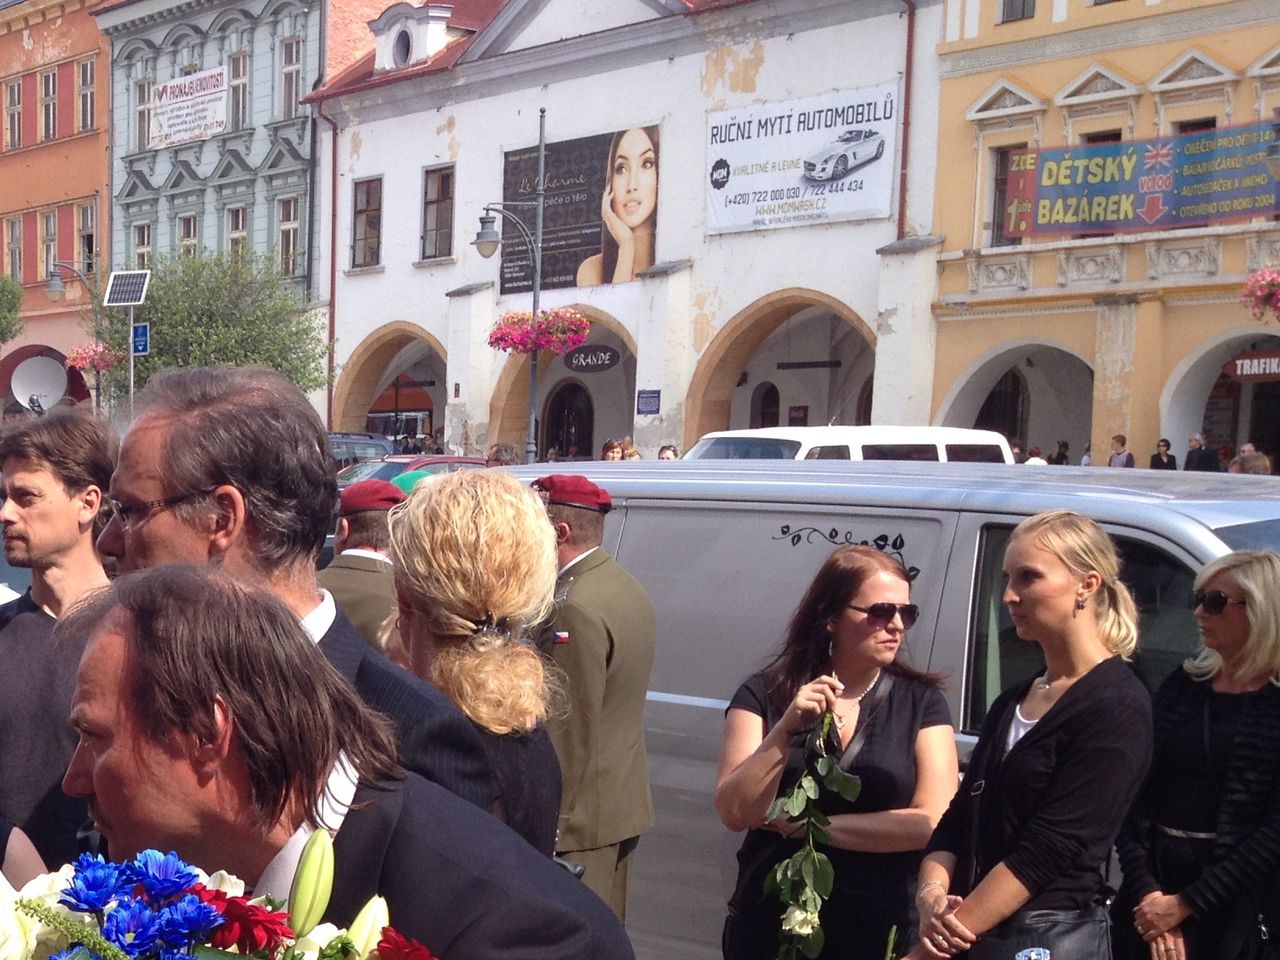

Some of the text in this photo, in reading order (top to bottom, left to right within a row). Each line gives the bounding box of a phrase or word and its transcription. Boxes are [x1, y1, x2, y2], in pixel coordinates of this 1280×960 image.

[710, 114, 753, 145] RUČNÍ
[797, 92, 894, 133] AUTOMOBILŮ
[1041, 146, 1138, 187] DĚTSKÝ
[752, 190, 769, 203] 722
[786, 186, 801, 199] 030
[810, 184, 826, 196] 722
[847, 179, 864, 192] 434
[1037, 189, 1135, 225] BAZÁREK
[572, 351, 613, 368] GRANDE
[1235, 358, 1280, 375] TRAFIK
